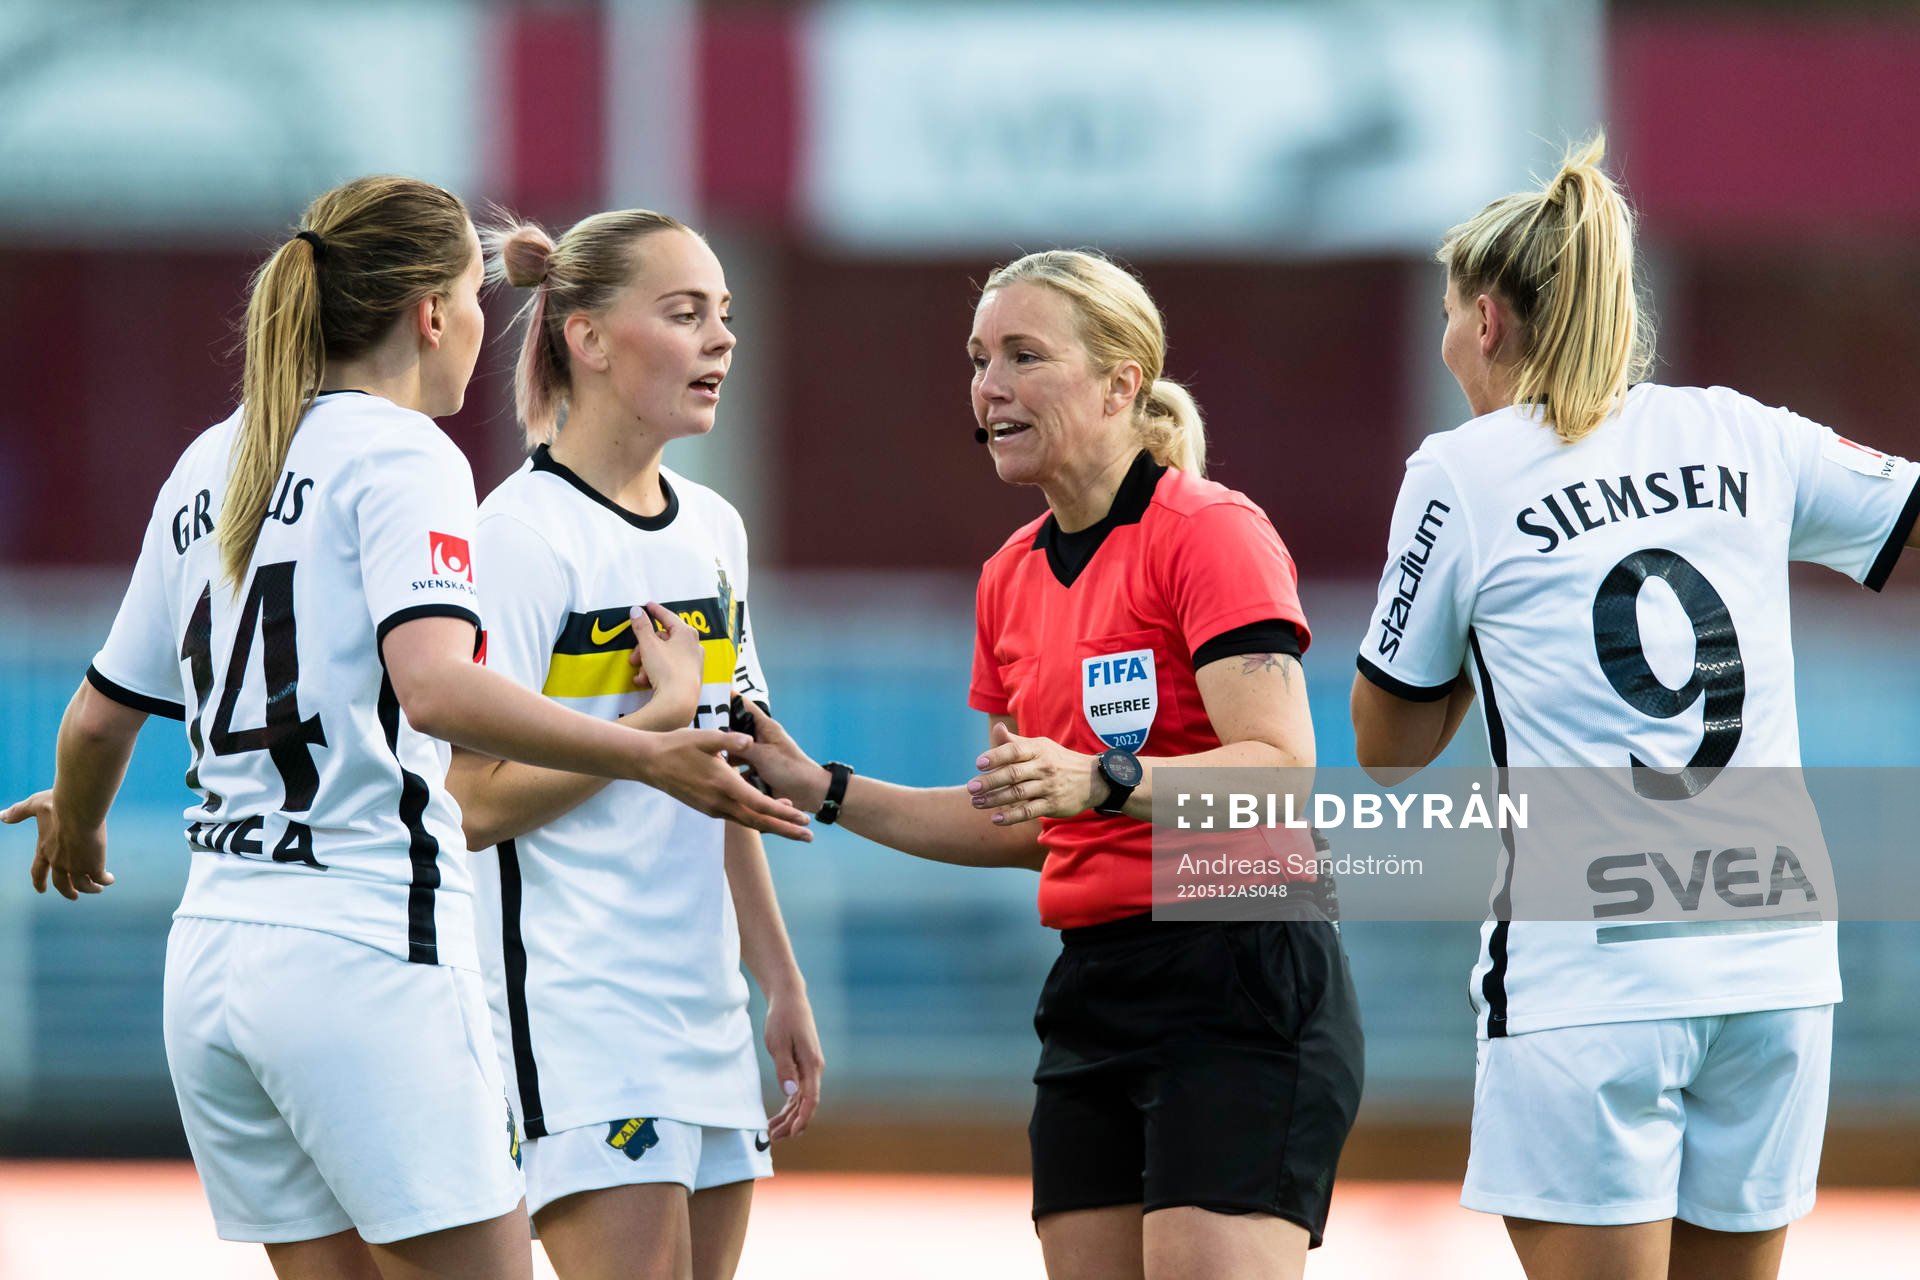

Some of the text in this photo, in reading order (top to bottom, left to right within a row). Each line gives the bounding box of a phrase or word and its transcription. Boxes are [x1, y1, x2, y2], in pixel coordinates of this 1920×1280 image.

[1517, 464, 1748, 553] SIEMSEN
[411, 579, 466, 592] SVENSKA
[1378, 499, 1451, 663] stadium
[181, 560, 328, 812] 14
[1088, 657, 1148, 688] FIFA
[1090, 697, 1151, 718] REFEREE
[1592, 547, 1746, 801] 9
[1113, 733, 1140, 747] 2022
[1586, 845, 1818, 919] SVEA
